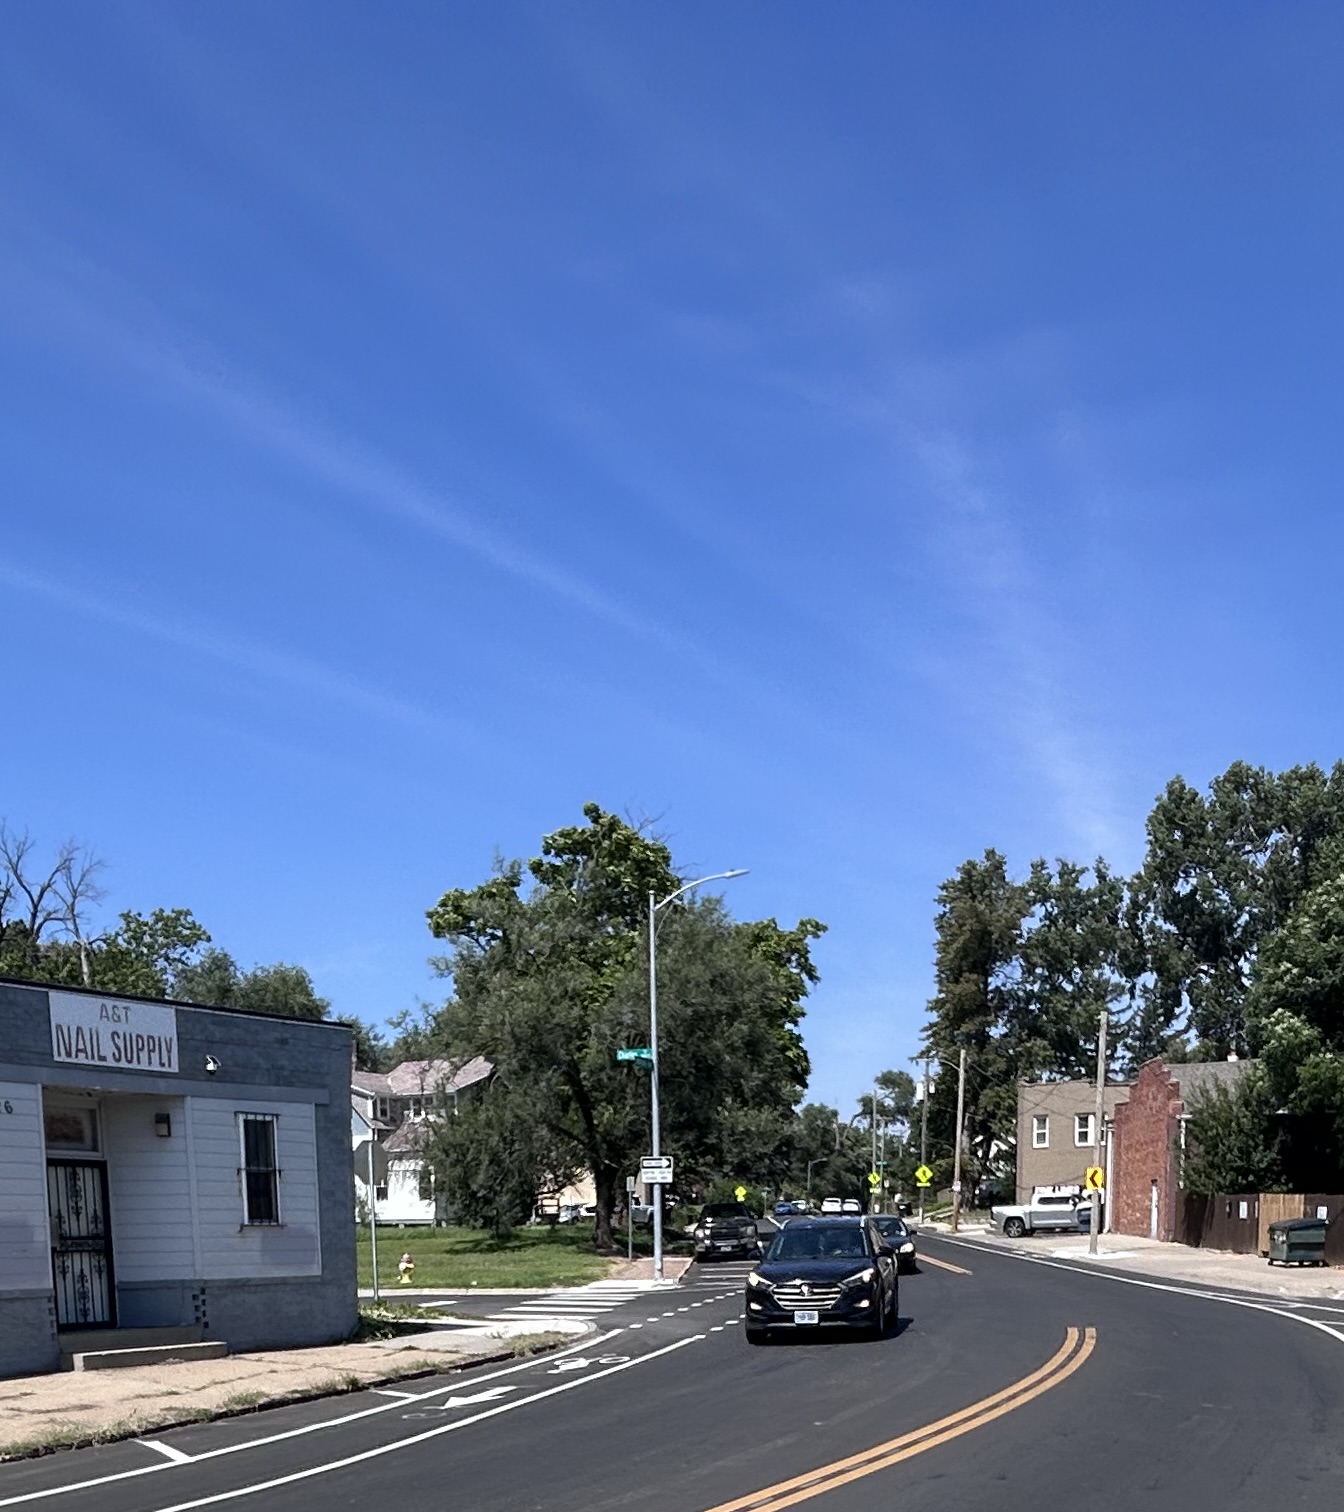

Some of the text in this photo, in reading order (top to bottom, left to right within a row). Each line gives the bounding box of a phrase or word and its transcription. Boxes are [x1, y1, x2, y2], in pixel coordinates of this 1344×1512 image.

[99, 1003, 131, 1024] A&T
[55, 1024, 173, 1069] NAIL SUPPLY
